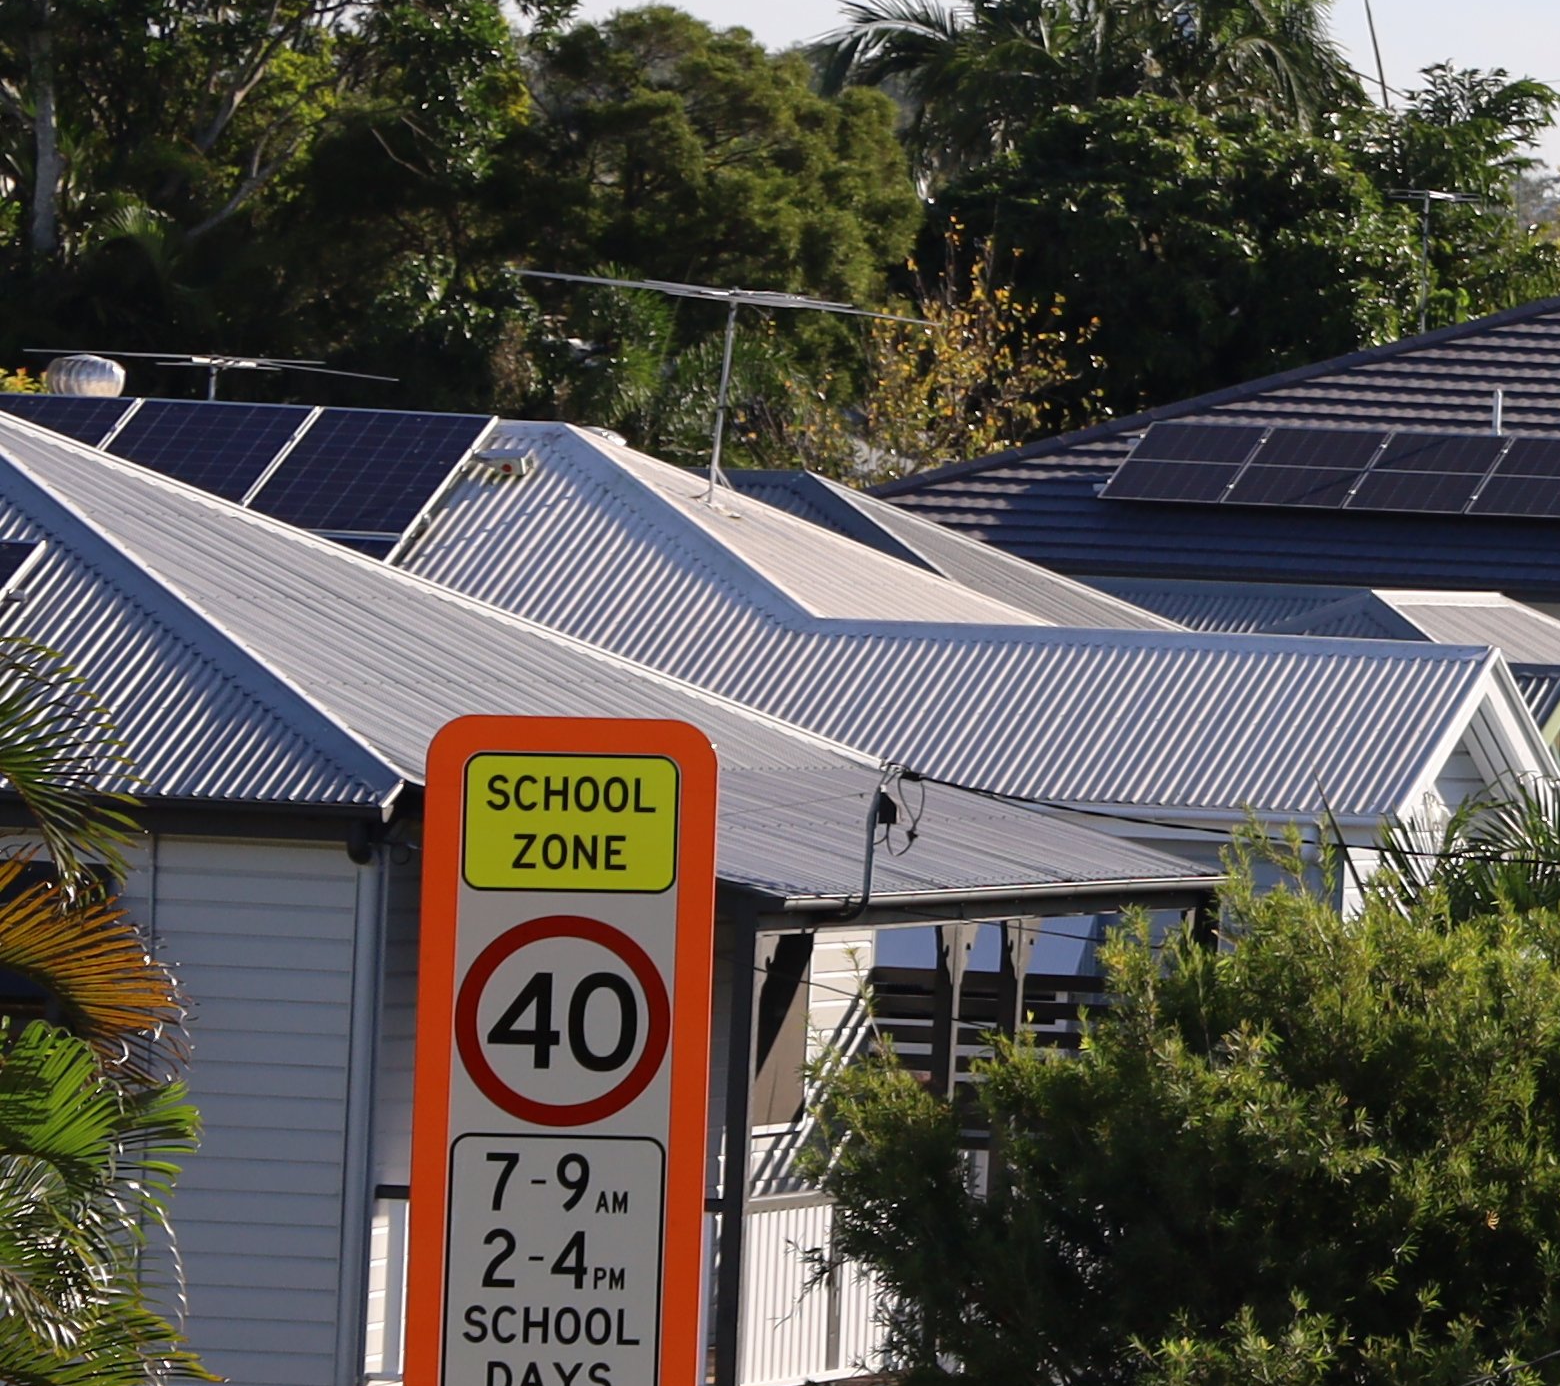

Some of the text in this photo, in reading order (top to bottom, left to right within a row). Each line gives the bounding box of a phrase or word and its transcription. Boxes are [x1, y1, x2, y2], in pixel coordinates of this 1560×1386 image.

[485, 774, 657, 814] SCHOOL
[511, 833, 628, 871] ZONE
[486, 971, 638, 1073] 40
[462, 1304, 641, 1346] SCHOOL
